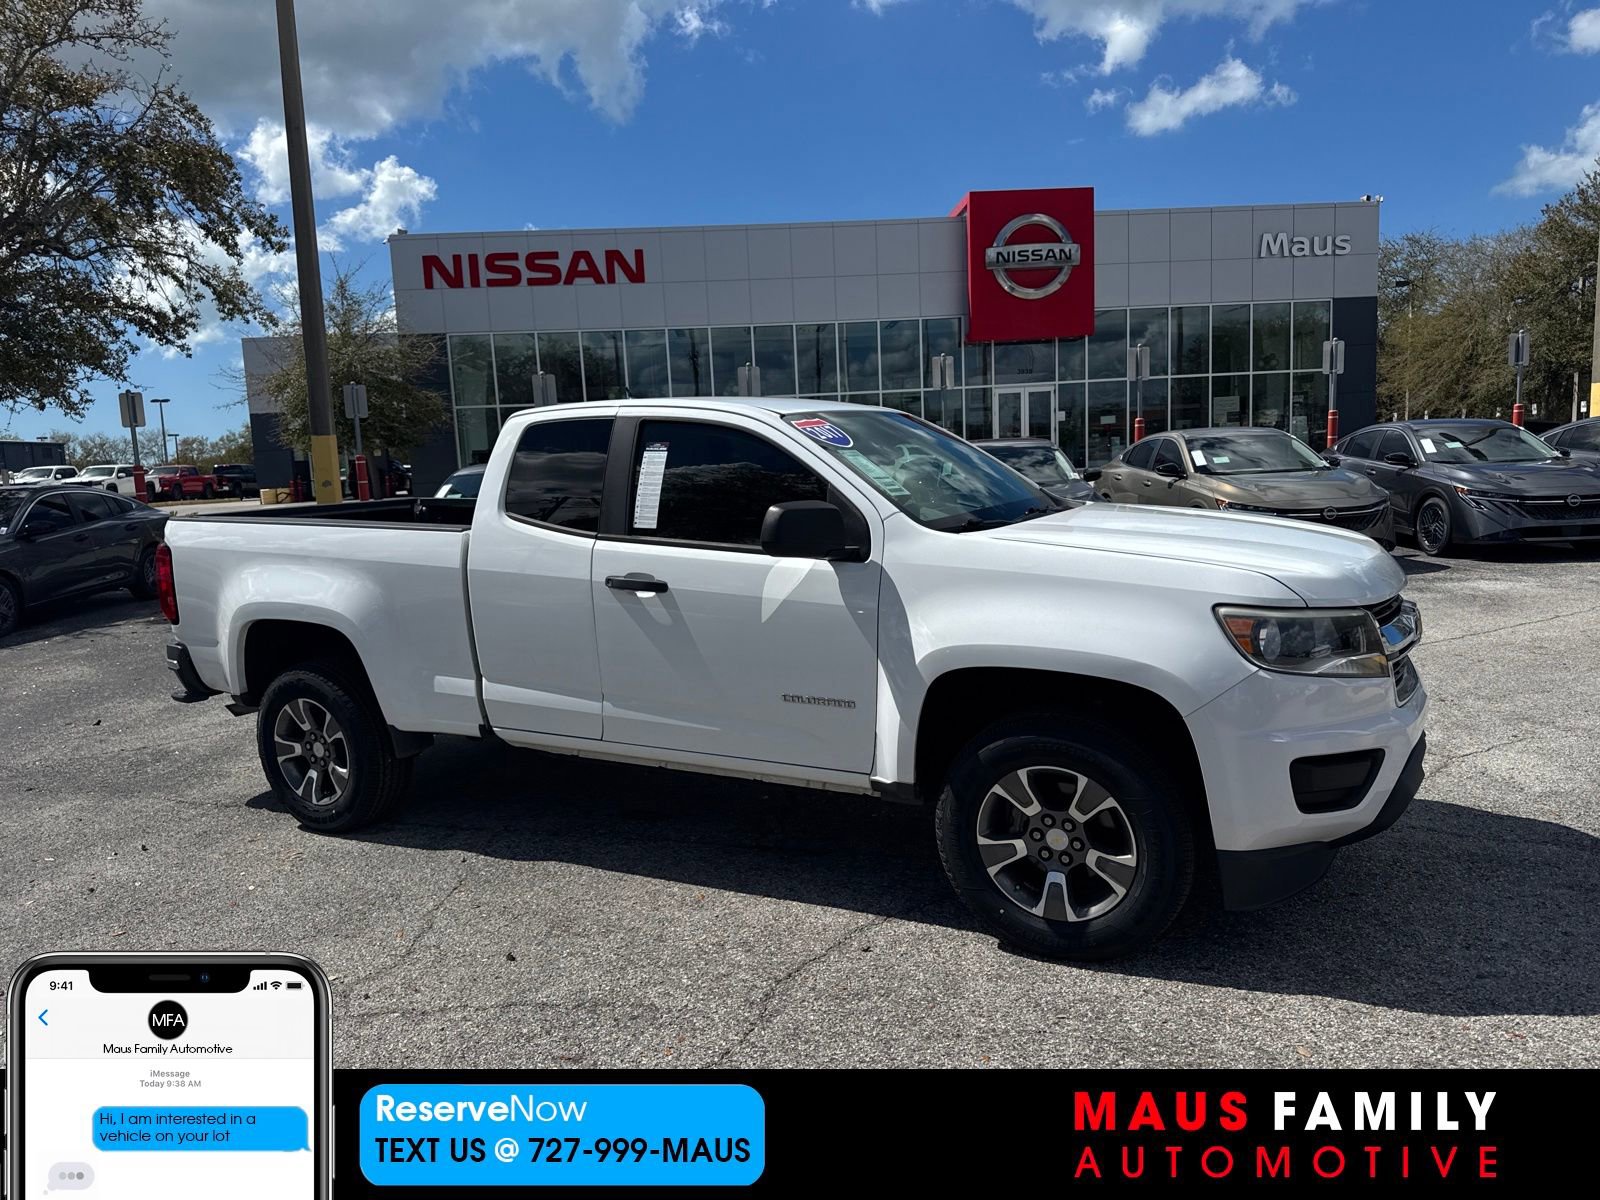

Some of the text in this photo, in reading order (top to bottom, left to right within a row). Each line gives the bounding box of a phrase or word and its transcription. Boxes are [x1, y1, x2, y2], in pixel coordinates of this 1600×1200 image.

[1259, 232, 1352, 258] Maus
[995, 248, 1072, 265] NISSAN
[421, 249, 646, 290] NISSAN
[805, 424, 844, 440] 2017
[781, 693, 857, 710] COLORADO
